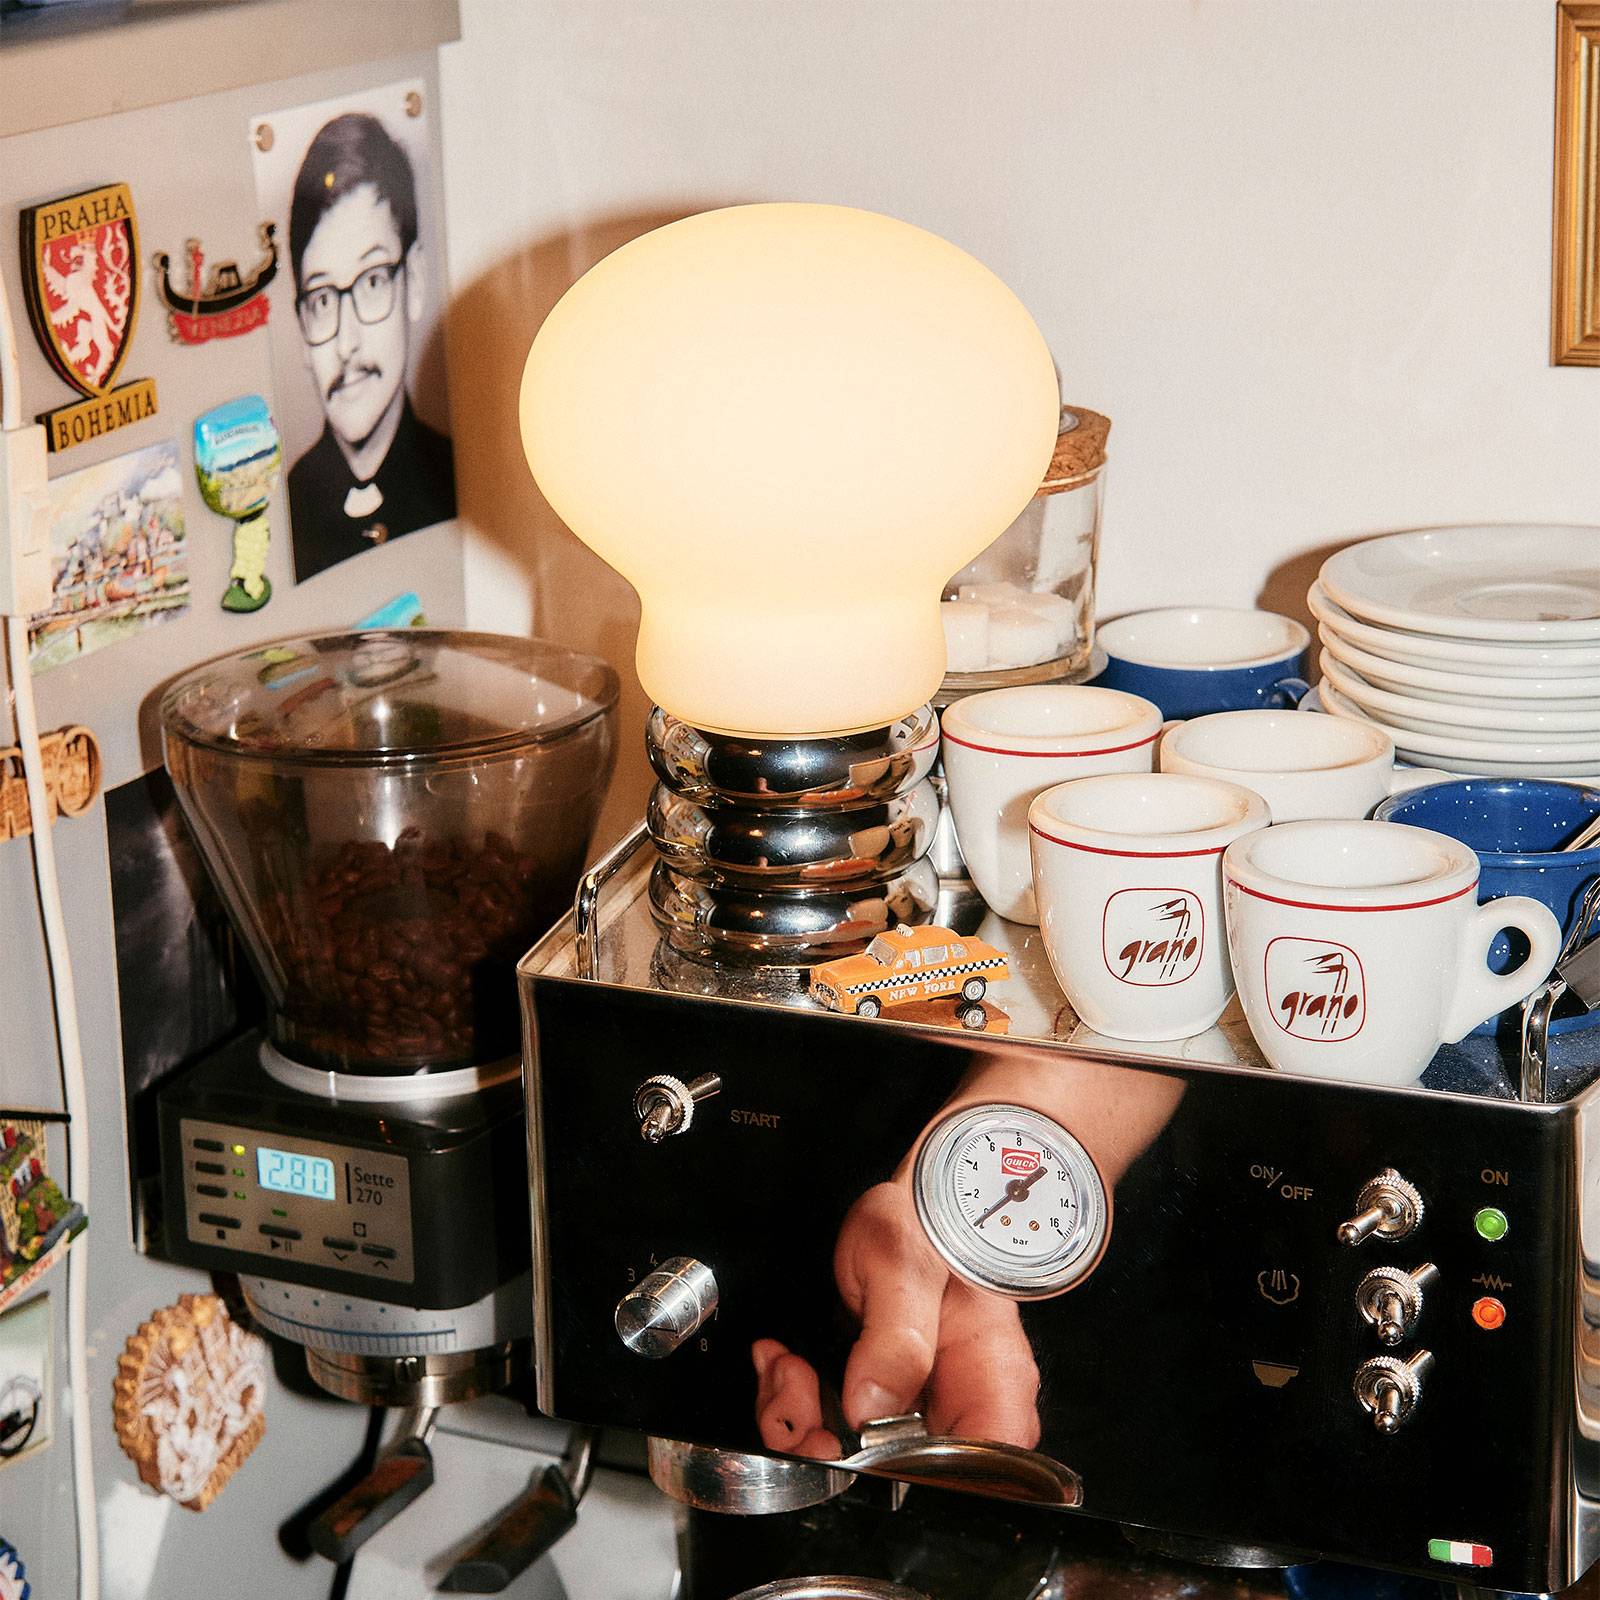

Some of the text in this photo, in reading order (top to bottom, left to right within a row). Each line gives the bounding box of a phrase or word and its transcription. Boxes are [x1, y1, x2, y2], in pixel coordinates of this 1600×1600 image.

[42, 194, 130, 240] PRAHA
[58, 391, 156, 449] BOHEMIA
[1118, 935, 1198, 979] grano
[889, 980, 957, 1001] NEW YORK
[1281, 991, 1358, 1035] grano
[730, 1109, 781, 1128] START
[989, 1142, 996, 1152] 6
[1016, 1137, 1022, 1147] 8
[1042, 1149, 1052, 1160] 10
[972, 1161, 979, 1171] 4
[1005, 1158, 1036, 1168] QUICK
[267, 1153, 328, 1195] 2.80
[353, 1166, 395, 1188] Sette
[1057, 1170, 1067, 1181] 12
[1481, 1169, 1509, 1186] ON
[355, 1188, 383, 1206] 270
[974, 1188, 980, 1198] 2
[1060, 1198, 1070, 1209] 14
[1049, 1217, 1060, 1228] 16
[1012, 1236, 1029, 1246] bar
[627, 1267, 636, 1282] 3
[700, 1338, 708, 1352] 8
